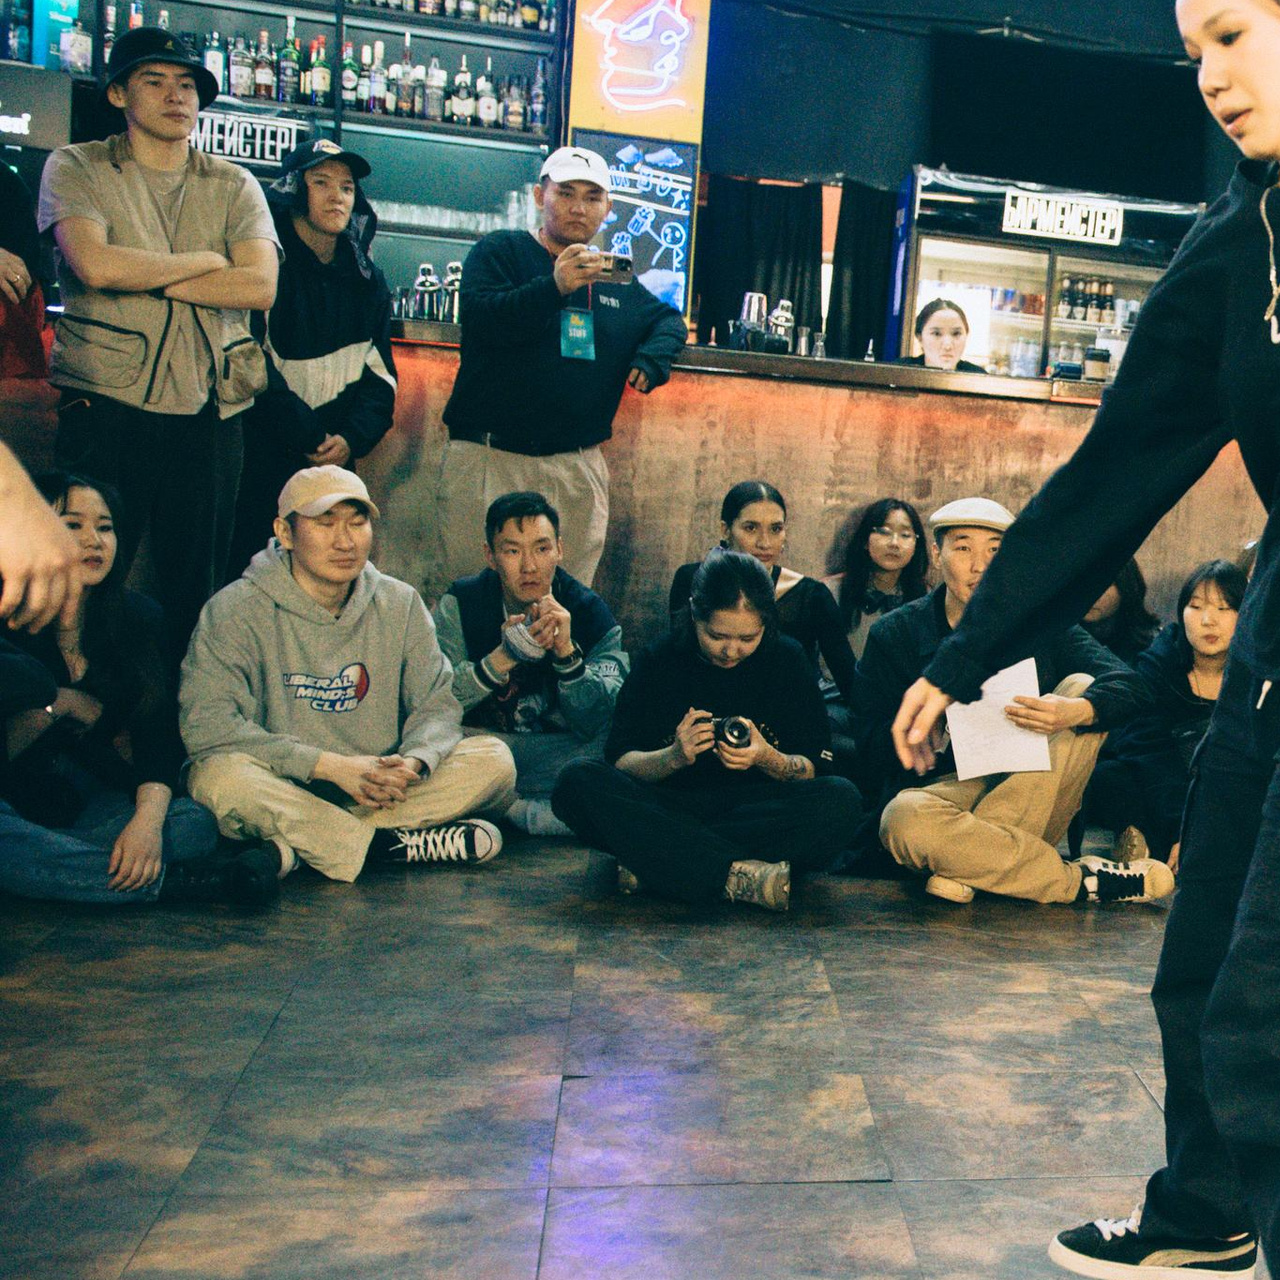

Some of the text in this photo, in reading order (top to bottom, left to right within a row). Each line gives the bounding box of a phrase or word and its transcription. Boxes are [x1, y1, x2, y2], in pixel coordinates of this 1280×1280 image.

[1006, 193, 1120, 240] БАРМЕЙСТЕР
[283, 673, 354, 689] LIBERAL
[311, 698, 358, 712] CLUB
